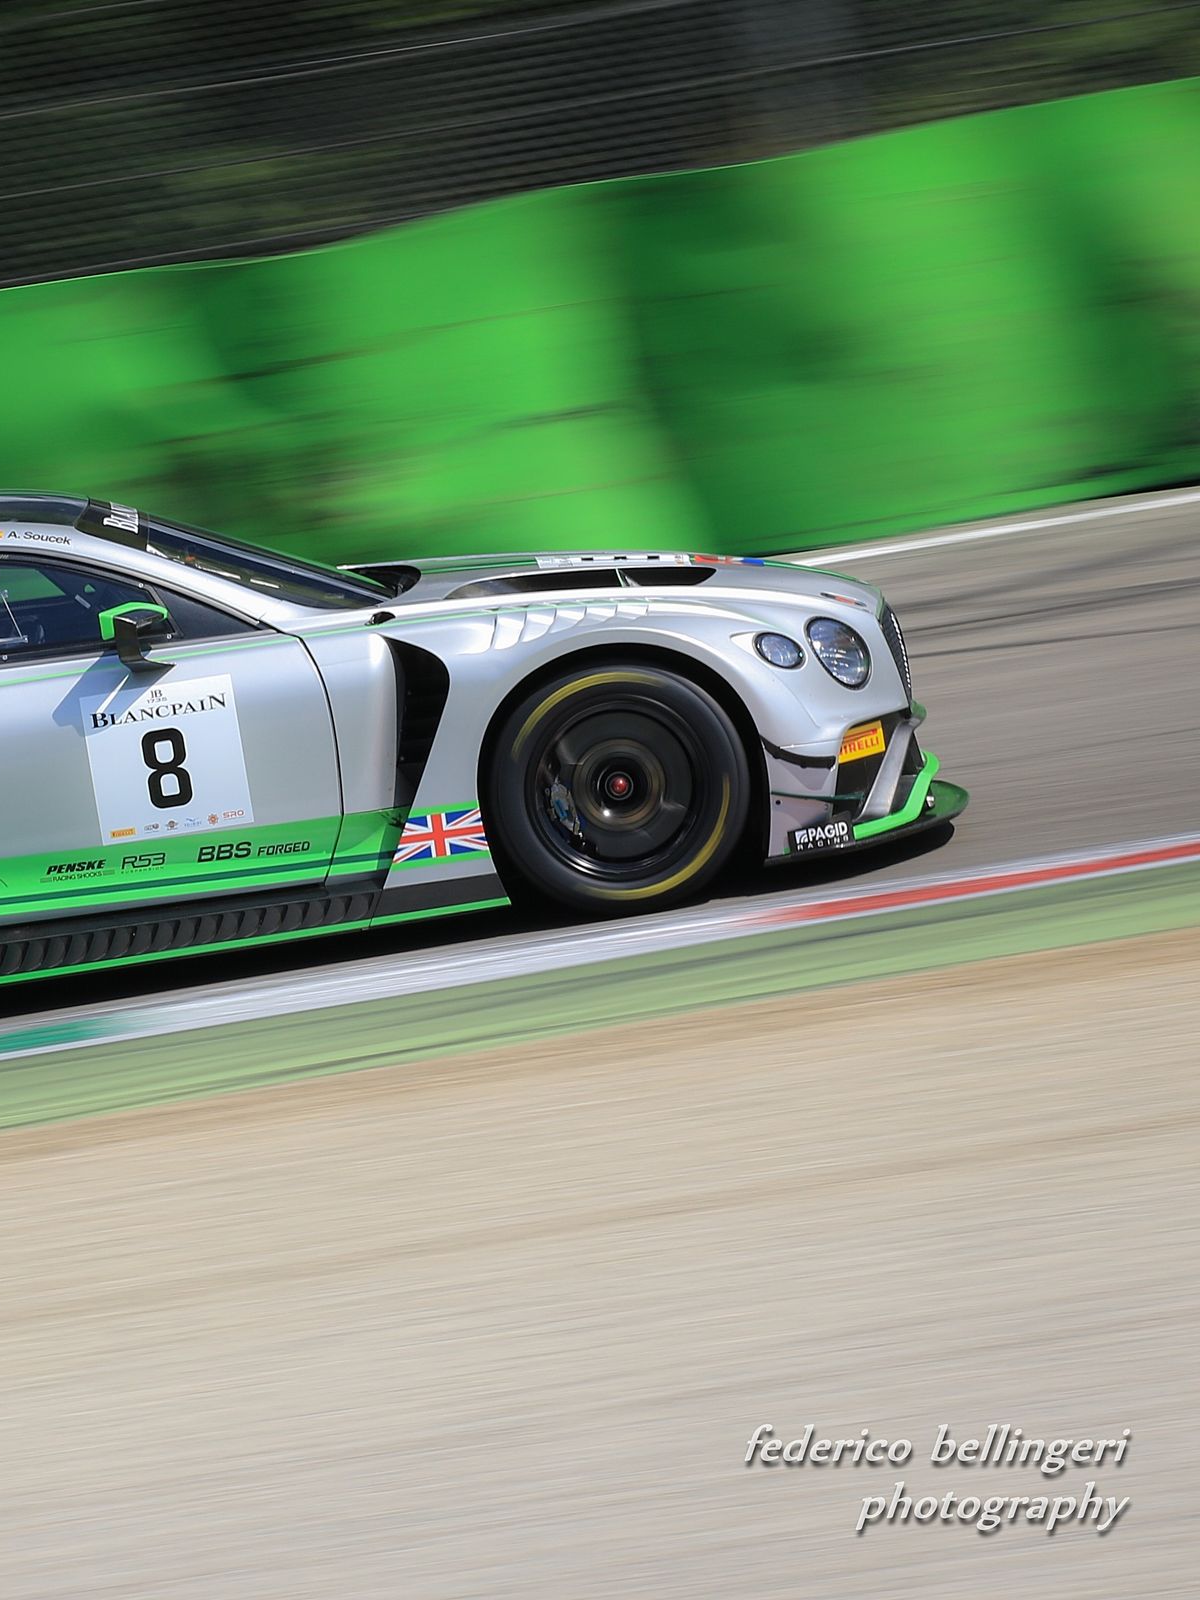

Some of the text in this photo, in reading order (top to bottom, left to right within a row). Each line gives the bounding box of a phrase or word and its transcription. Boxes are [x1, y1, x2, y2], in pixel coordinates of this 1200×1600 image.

[7, 531, 21, 539] A.
[23, 532, 71, 545] Soucek
[90, 692, 226, 729] BLANCPAIN
[141, 727, 194, 809] 8
[222, 810, 244, 819] SRO
[808, 822, 848, 842] PAGID
[197, 841, 311, 863] BBS FORGED
[797, 835, 849, 851] RACING
[46, 859, 107, 875] PENSKE
[121, 852, 166, 870] R53
